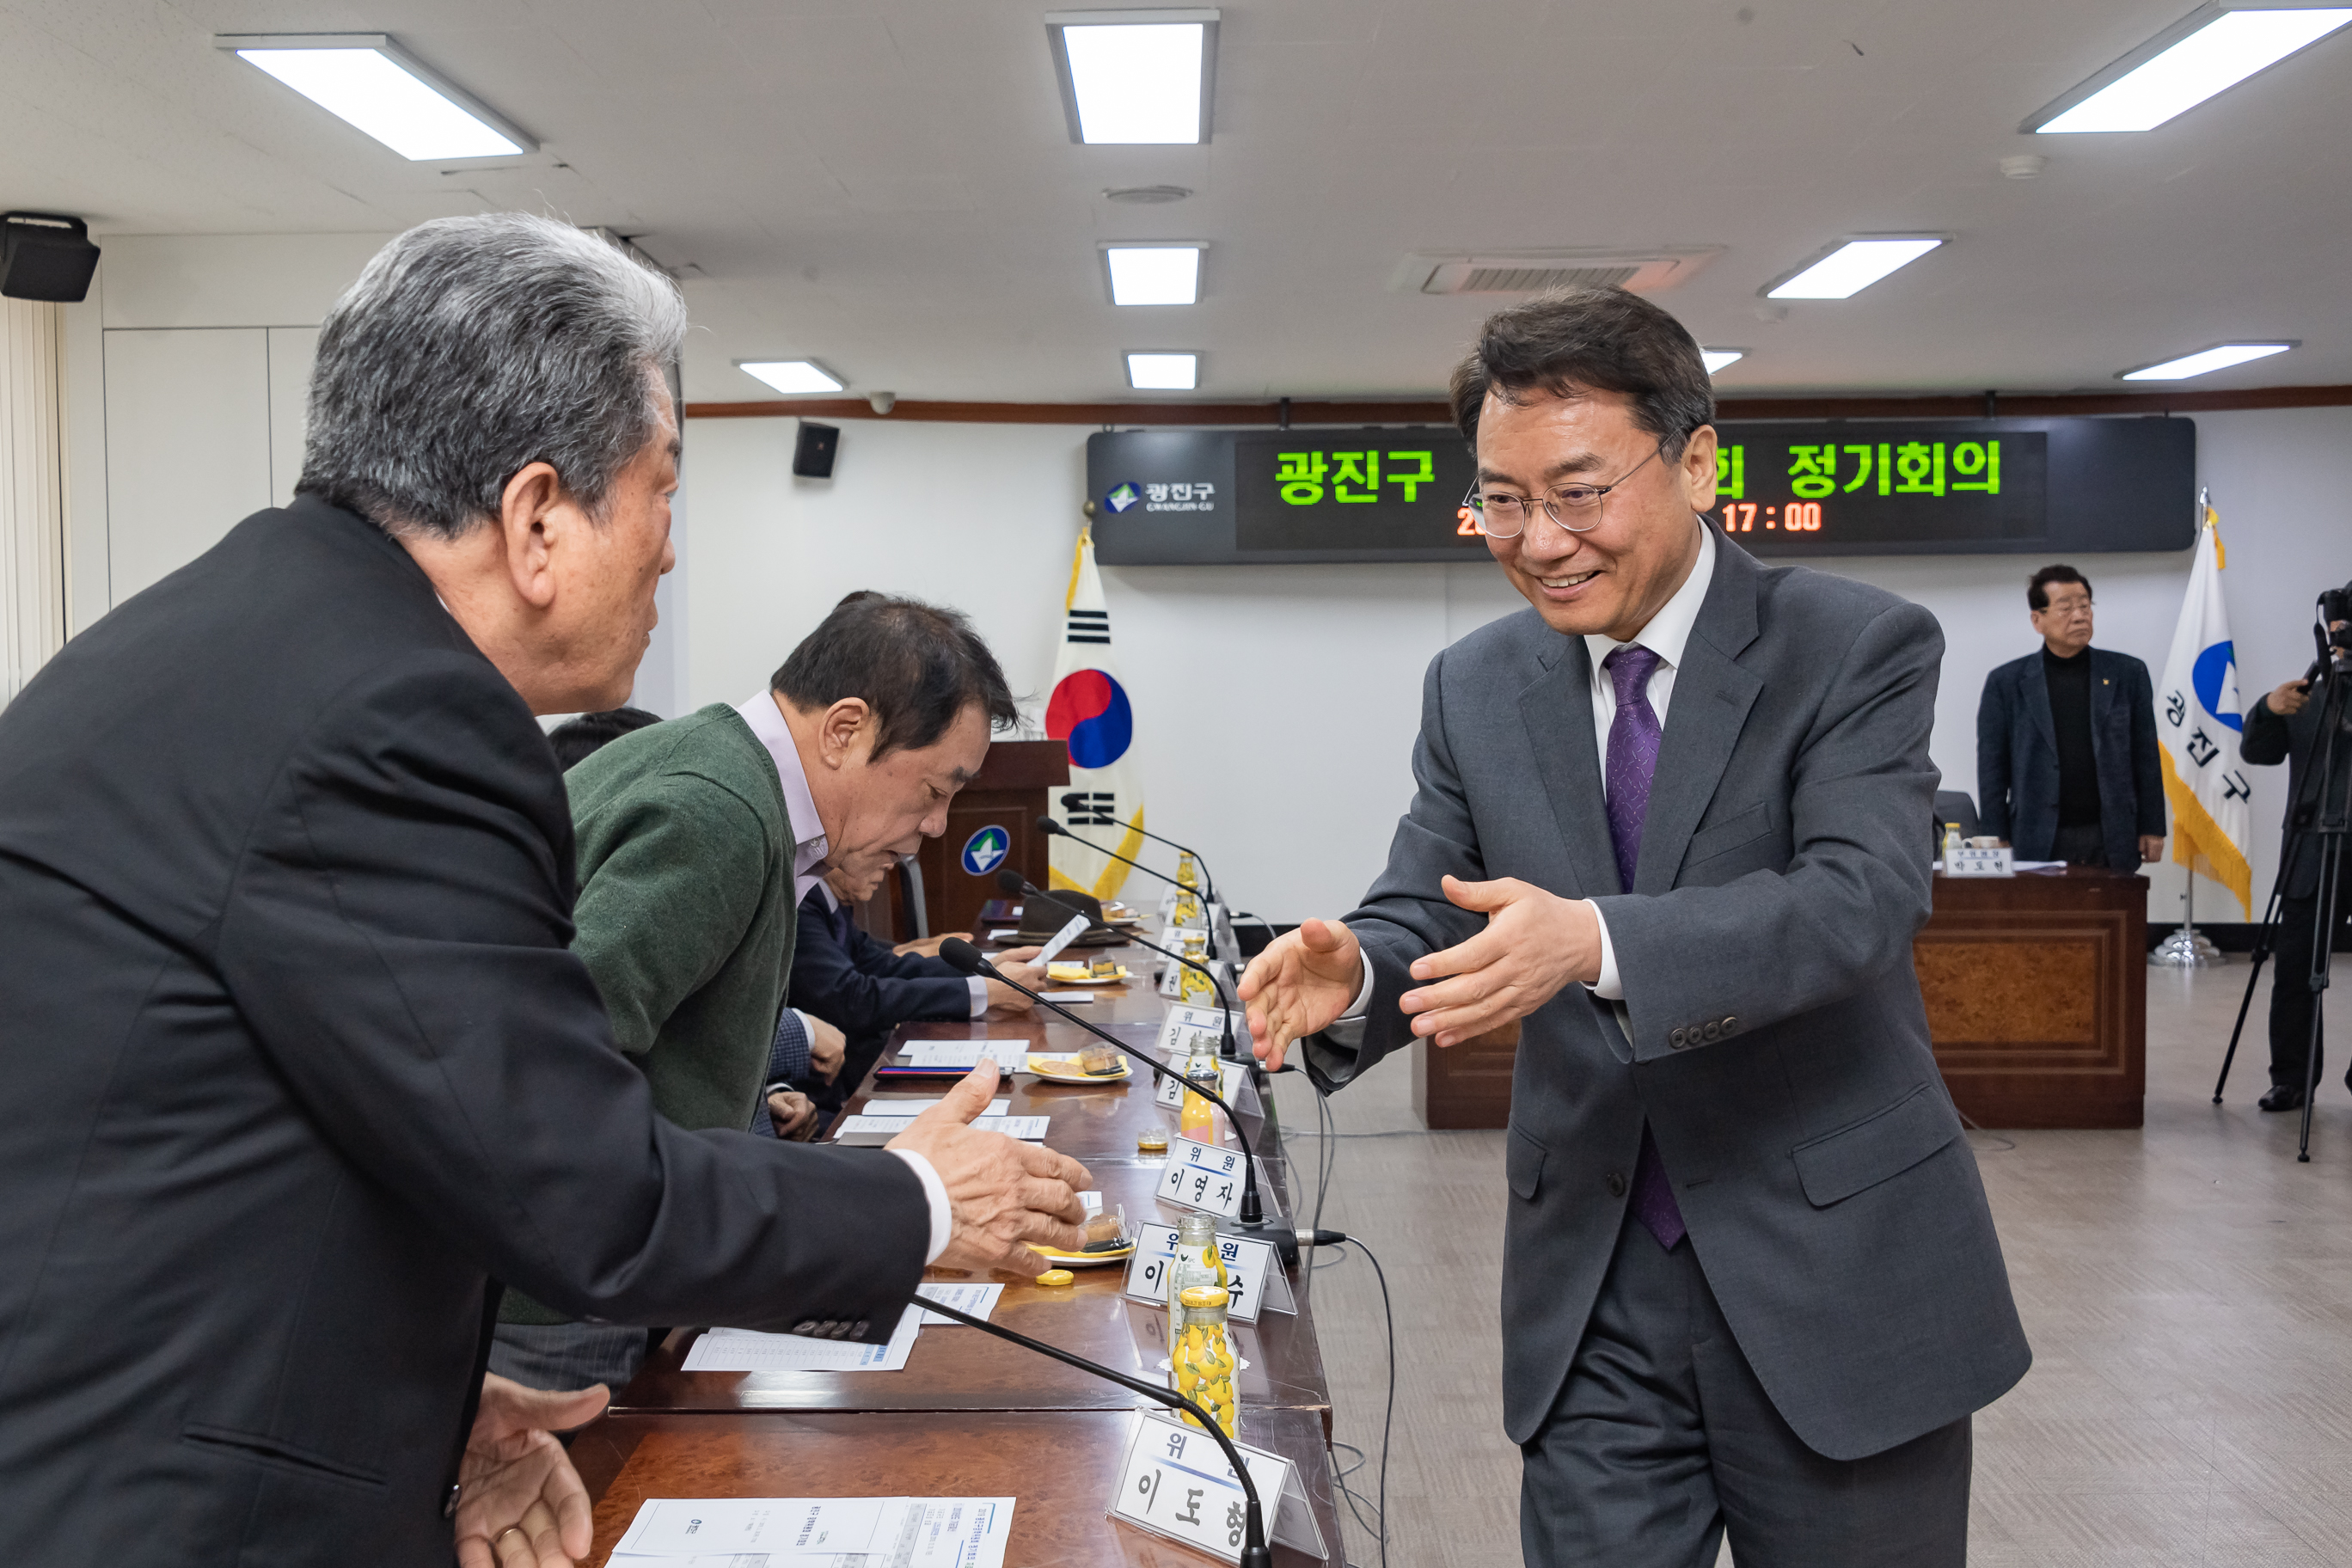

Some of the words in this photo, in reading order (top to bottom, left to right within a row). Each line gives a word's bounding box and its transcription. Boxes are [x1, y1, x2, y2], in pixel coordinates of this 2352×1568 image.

[1145, 482, 1216, 502] 광진구
[1275, 450, 1436, 505] 광진구
[1787, 440, 2001, 499] 정기회의
[2165, 689, 2251, 804] 광진구
